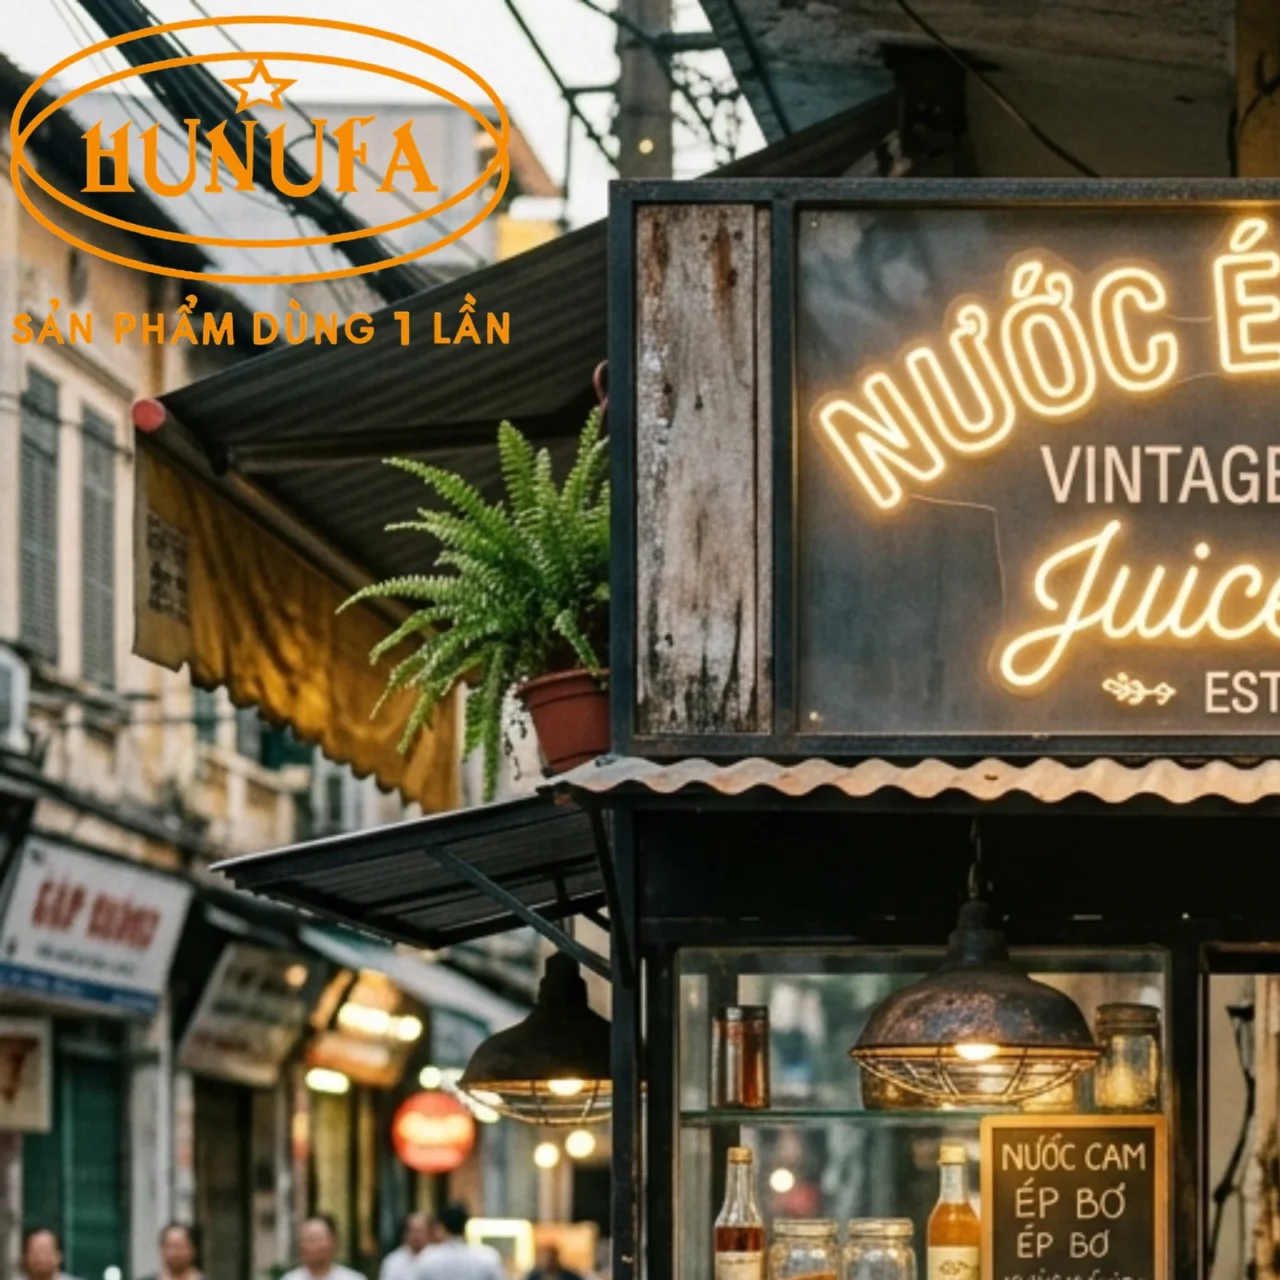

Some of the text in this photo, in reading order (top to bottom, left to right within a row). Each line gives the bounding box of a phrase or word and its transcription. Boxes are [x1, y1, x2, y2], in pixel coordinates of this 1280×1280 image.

[820, 261, 1179, 510] NƯỚC
[1084, 1142, 1146, 1171] CAM
[1015, 1177, 1060, 1219] ÉP
[1016, 1224, 1054, 1258] ÉP
